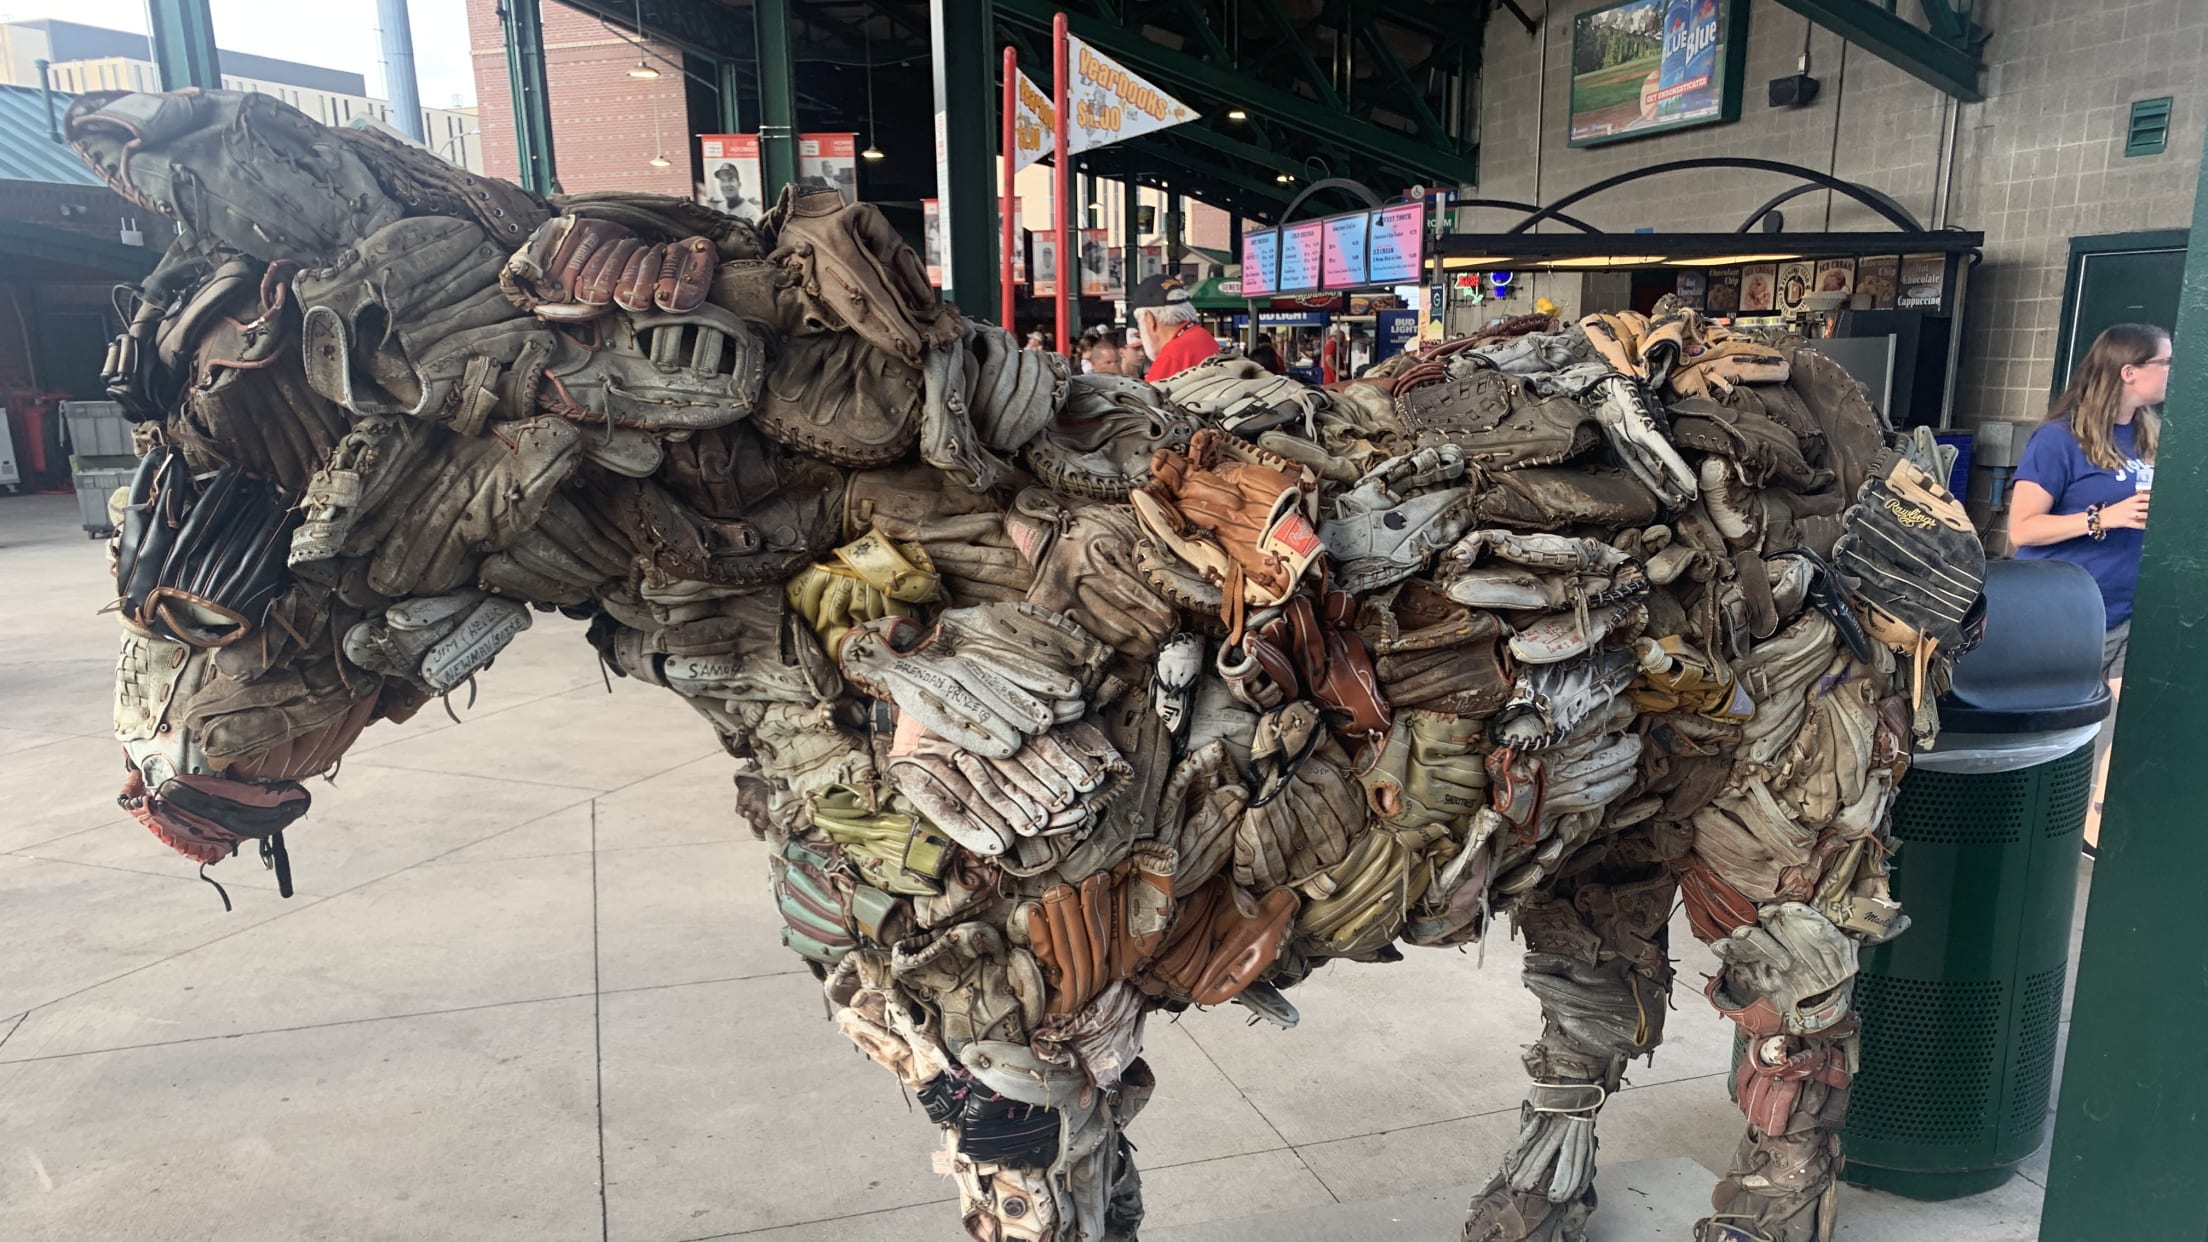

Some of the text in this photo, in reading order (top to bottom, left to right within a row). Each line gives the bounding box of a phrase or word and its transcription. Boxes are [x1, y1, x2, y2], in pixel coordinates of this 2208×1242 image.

[1686, 20, 1717, 64] Blue
[1079, 48, 1169, 122] Yearbooks
[1897, 296, 1941, 309] Cappuccino
[1395, 318, 1415, 326] BUD
[1884, 498, 1937, 528] Rawlings
